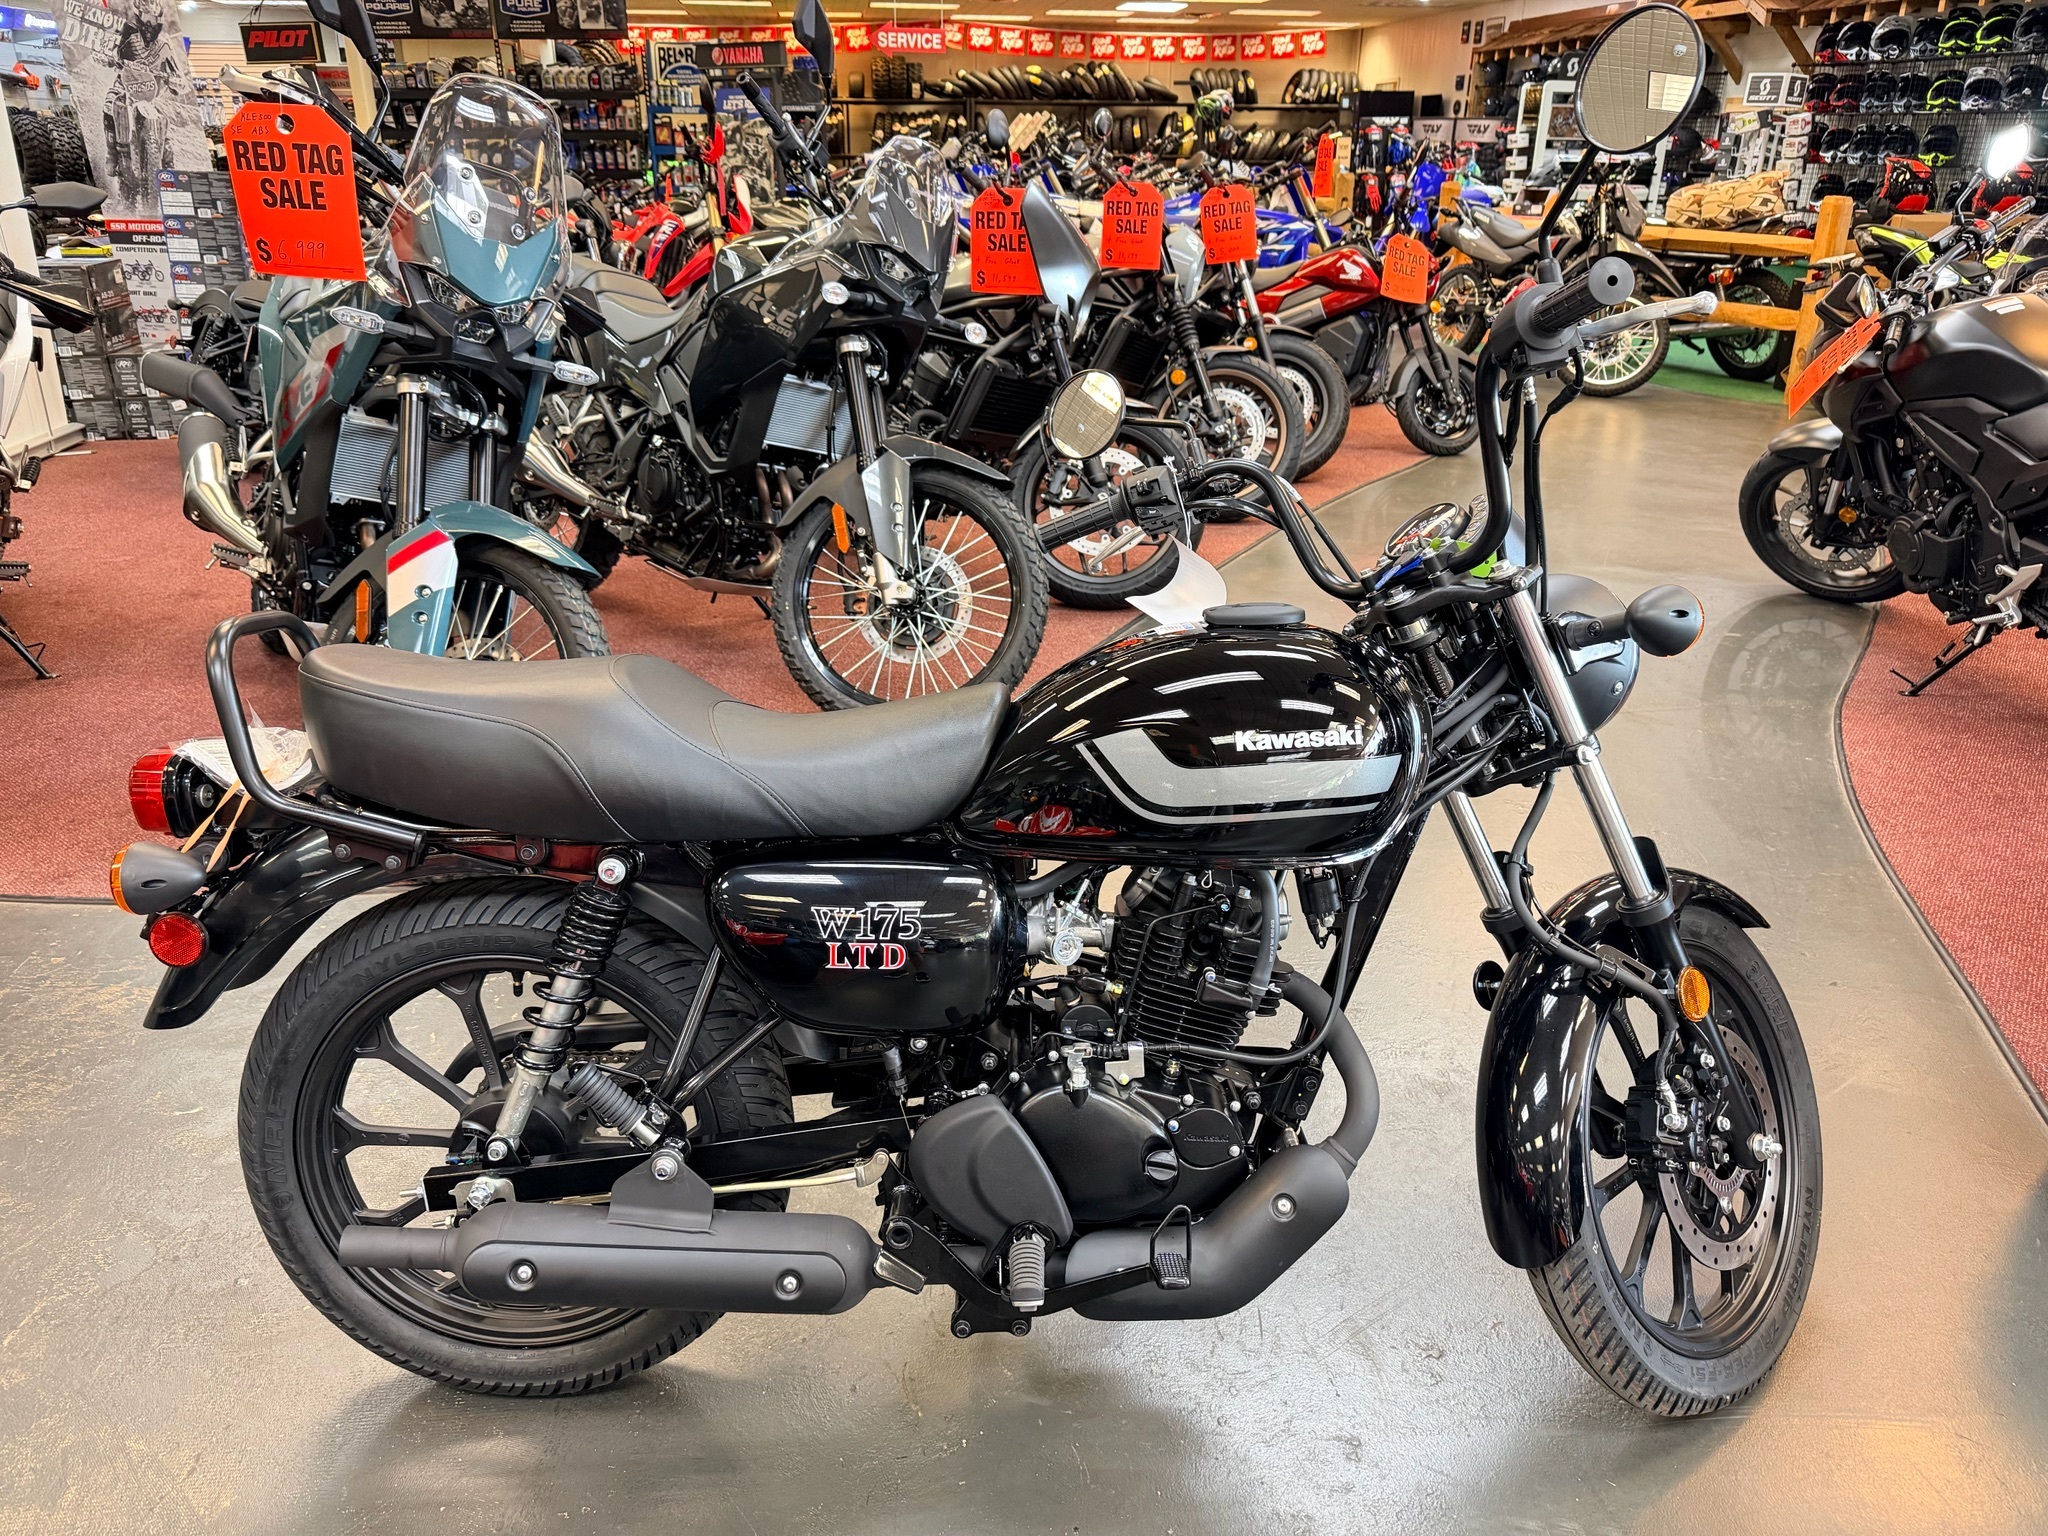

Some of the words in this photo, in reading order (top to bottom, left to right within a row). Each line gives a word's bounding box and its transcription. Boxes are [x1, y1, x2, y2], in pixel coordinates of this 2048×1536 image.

[366, 2, 411, 10] POLARIS
[506, 0, 542, 8] PURE
[63, 0, 84, 17] WE
[84, 5, 127, 32] KNOW
[62, 17, 122, 56] DIRT
[248, 29, 309, 48] PILOT
[878, 31, 942, 49] SERVICE
[723, 46, 765, 64] YAMAHA
[230, 125, 242, 135] SE
[251, 126, 270, 135] ABS
[232, 140, 287, 172] RED
[291, 142, 345, 176] TAG
[260, 177, 328, 211] SALE
[1106, 200, 1132, 216] RED
[1136, 201, 1159, 217] TAG
[1203, 203, 1226, 219] RED
[1228, 200, 1251, 215] TAG
[110, 222, 126, 230] SSR
[128, 223, 164, 231] MOTORS
[975, 211, 1006, 229] RED
[1011, 211, 1027, 230] TA
[1115, 218, 1148, 234] SALE
[1213, 217, 1243, 234] SALE
[132, 234, 166, 243] OFF-ROA
[987, 233, 1027, 253] SALE
[255, 237, 273, 265] $
[277, 239, 326, 264] 6,999
[1105, 248, 1113, 262] $
[1208, 247, 1216, 260] $
[1388, 245, 1405, 262] RED
[1407, 251, 1425, 266] TAG
[976, 270, 986, 286] $
[1392, 262, 1417, 278] SALE
[1384, 282, 1390, 292] $
[740, 291, 798, 330] KLE
[1234, 723, 1364, 752] Kawasaki
[810, 906, 922, 940] W175
[353, 934, 518, 988] NYLOGRIP
[825, 942, 907, 970] LTD
[1754, 974, 1796, 1041] MRF
[262, 1090, 291, 1185] MRF
